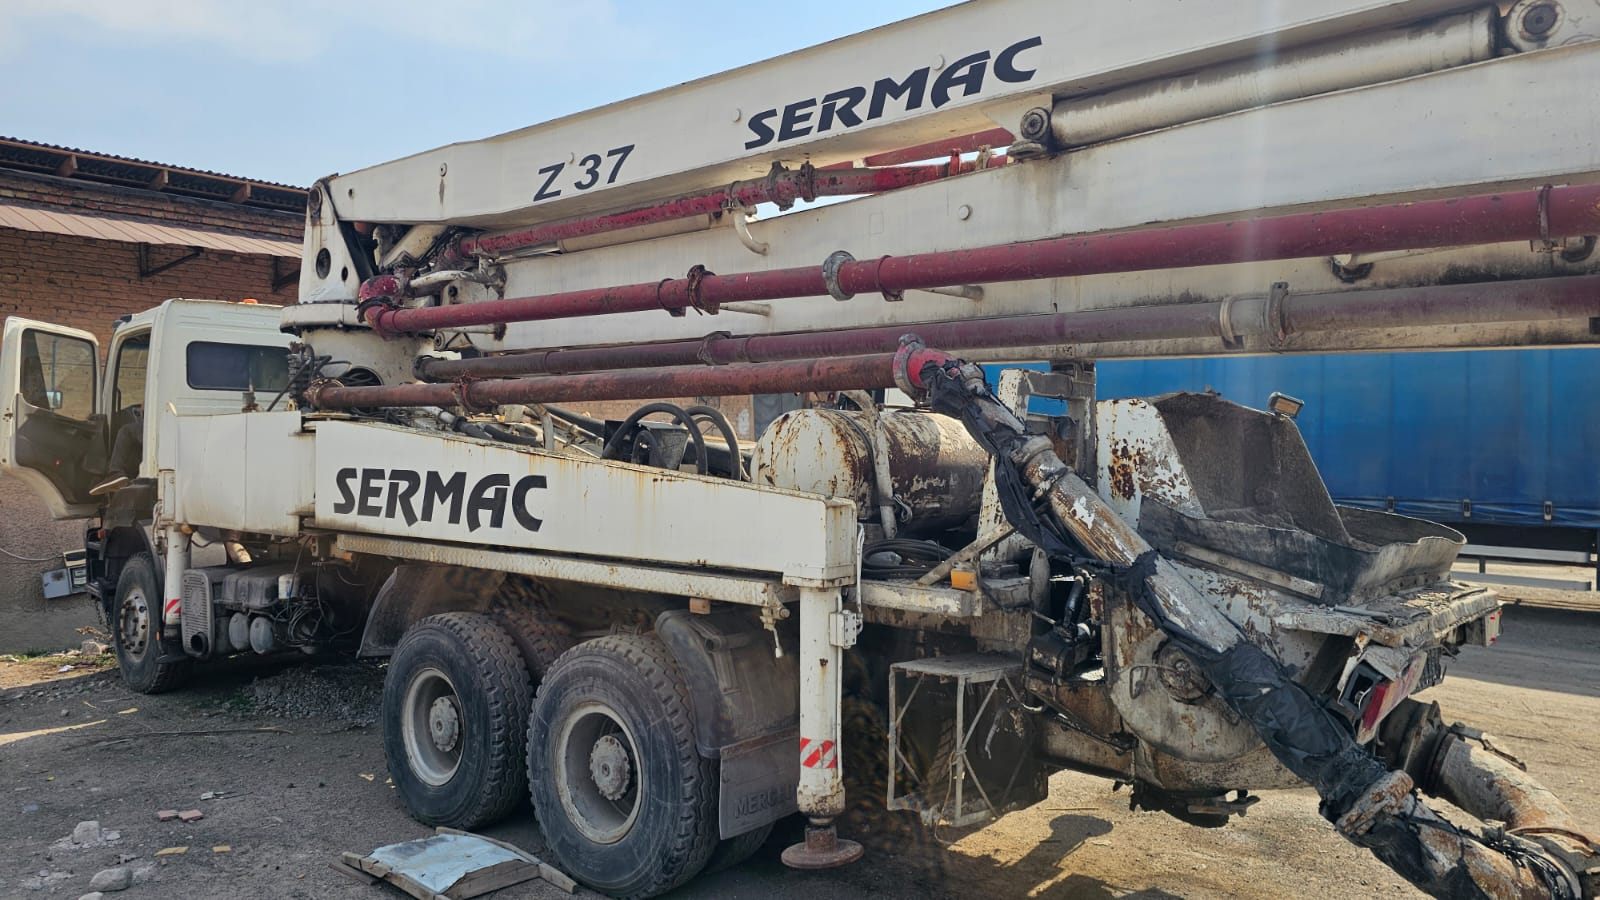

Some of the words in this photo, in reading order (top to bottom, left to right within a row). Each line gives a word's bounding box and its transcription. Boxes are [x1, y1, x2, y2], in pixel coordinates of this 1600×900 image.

[744, 36, 1042, 150] SERMAC
[533, 162, 566, 202] Z
[574, 144, 635, 191] 37
[333, 467, 548, 533] SERMAC
